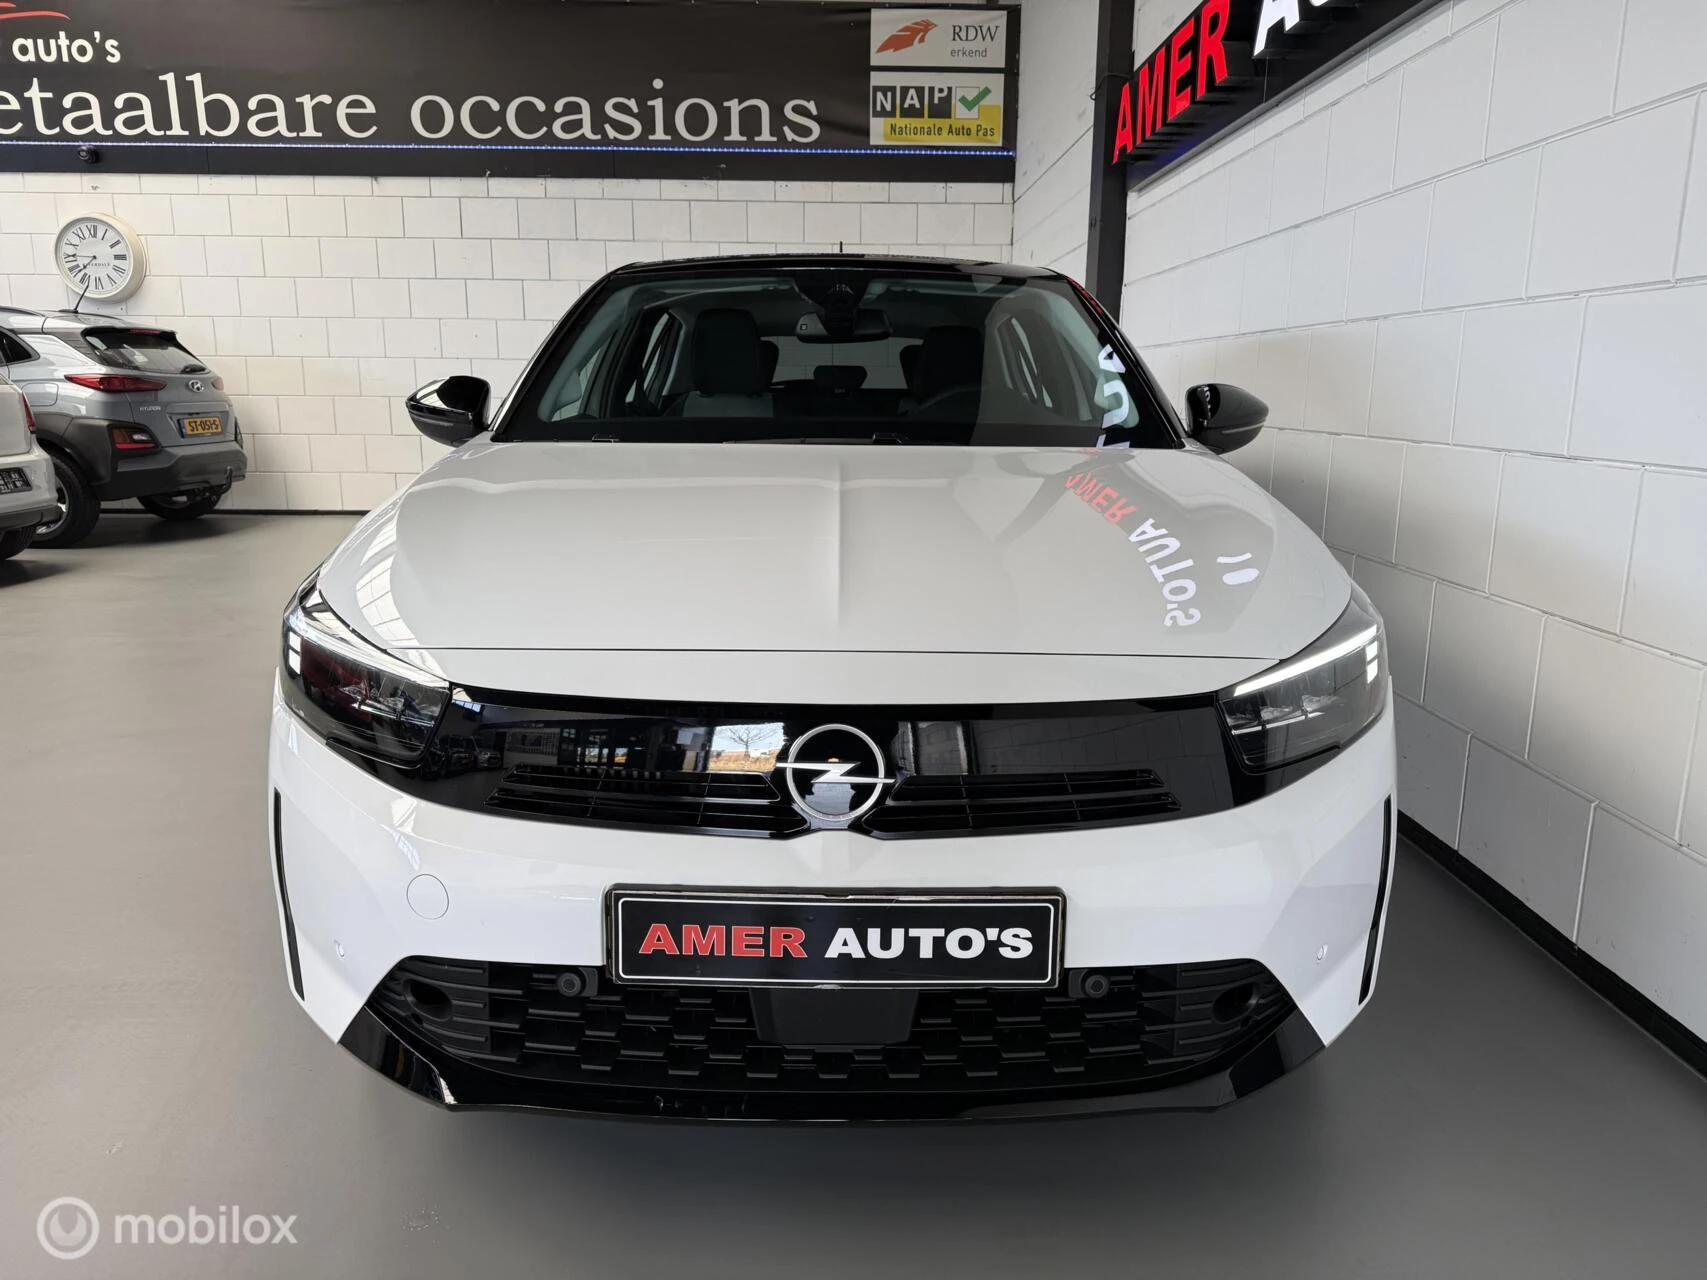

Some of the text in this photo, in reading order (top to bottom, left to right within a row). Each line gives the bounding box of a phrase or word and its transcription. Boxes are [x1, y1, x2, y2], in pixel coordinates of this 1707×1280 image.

[12, 31, 121, 64] auto's
[952, 25, 1000, 42] RDW
[950, 47, 987, 58] erkend
[1112, 0, 1230, 164] AMER
[410, 78, 822, 143] occasions
[890, 123, 995, 137] Nationale Auto Pas
[638, 923, 1034, 960] AMER AUTO'S
